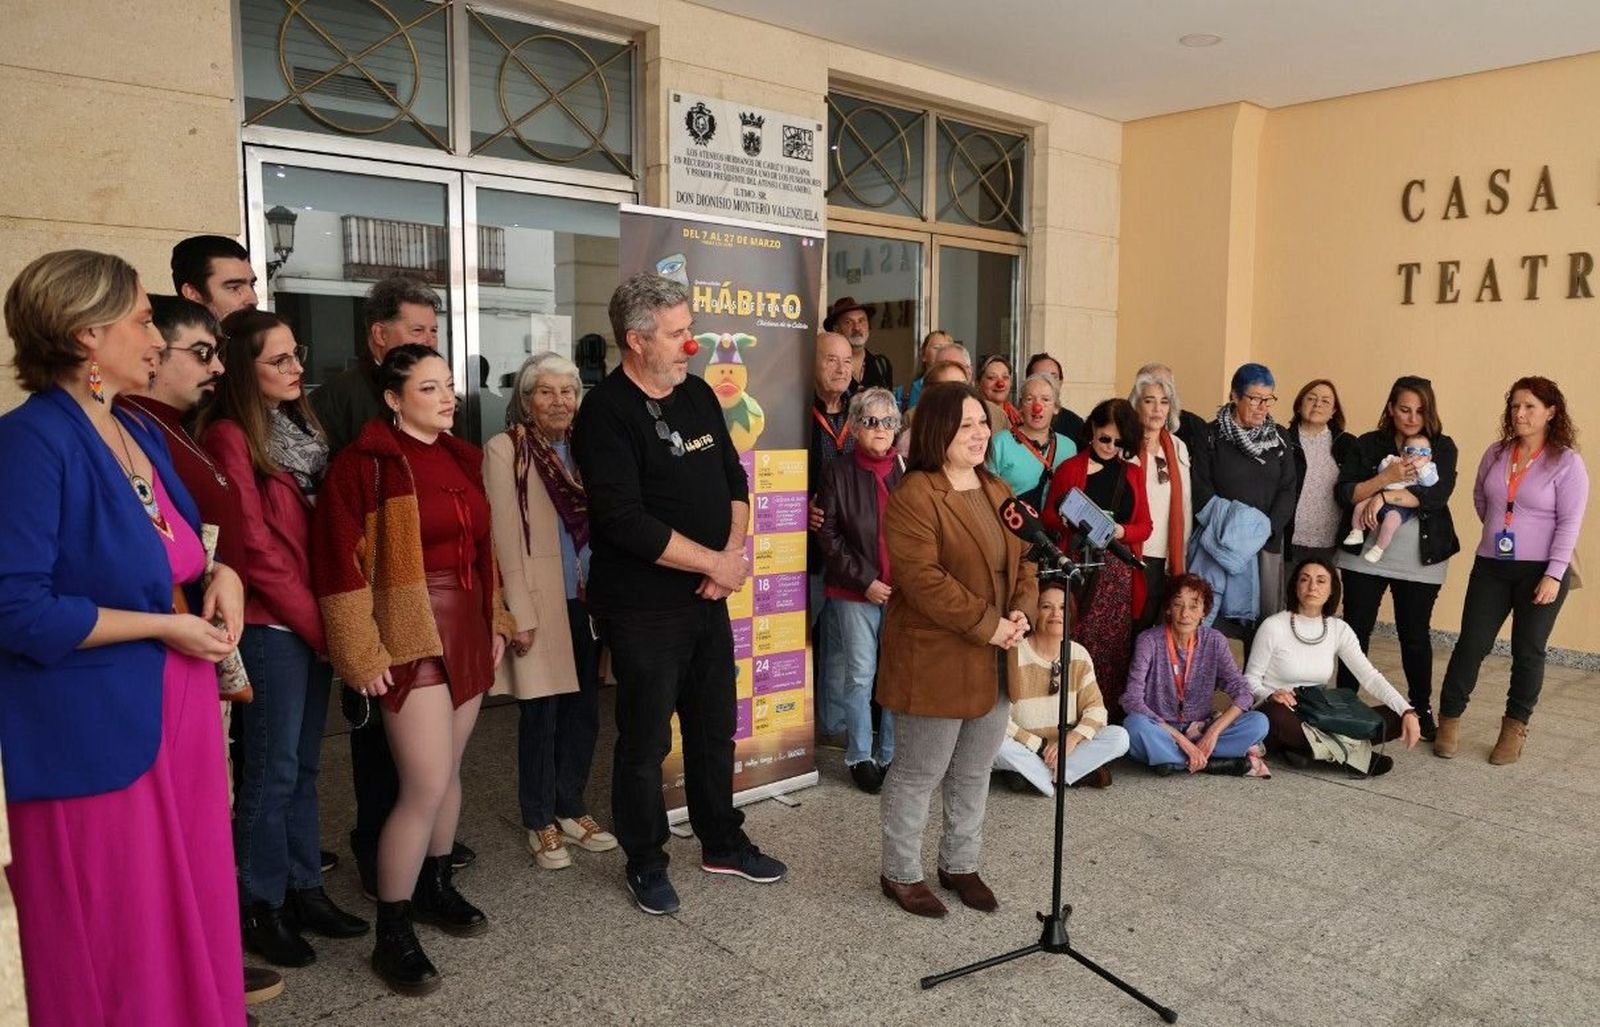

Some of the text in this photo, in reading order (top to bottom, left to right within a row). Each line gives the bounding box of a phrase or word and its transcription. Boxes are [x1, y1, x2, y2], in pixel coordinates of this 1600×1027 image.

[673, 155, 681, 164] EN
[683, 156, 713, 169] RECUERDO
[714, 161, 720, 171] DE
[722, 163, 739, 174] QUIEN
[740, 166, 757, 177] FUERA
[758, 169, 770, 179] UNO
[770, 171, 777, 180] DE
[778, 172, 788, 182] LOS
[686, 148, 697, 157] LOS
[699, 150, 723, 162] ATENEOS
[755, 159, 761, 168] DE
[691, 167, 711, 178] PRIMER
[713, 171, 745, 184] PRESIDENTE
[746, 176, 756, 186] DEL
[758, 178, 777, 189] ATENEO
[1401, 165, 1558, 223] CASA
[676, 191, 819, 222] DON DIONISIO MONTERO VALENZUELA
[682, 228, 700, 239] DEL
[702, 231, 707, 239] 7
[709, 231, 721, 242] AL
[723, 233, 735, 243] 27
[736, 235, 748, 244] DE
[750, 236, 781, 249] MARZO
[692, 280, 801, 320] HÁBITO
[757, 496, 769, 509] 12
[759, 578, 770, 591] 18
[756, 659, 769, 673] 24
